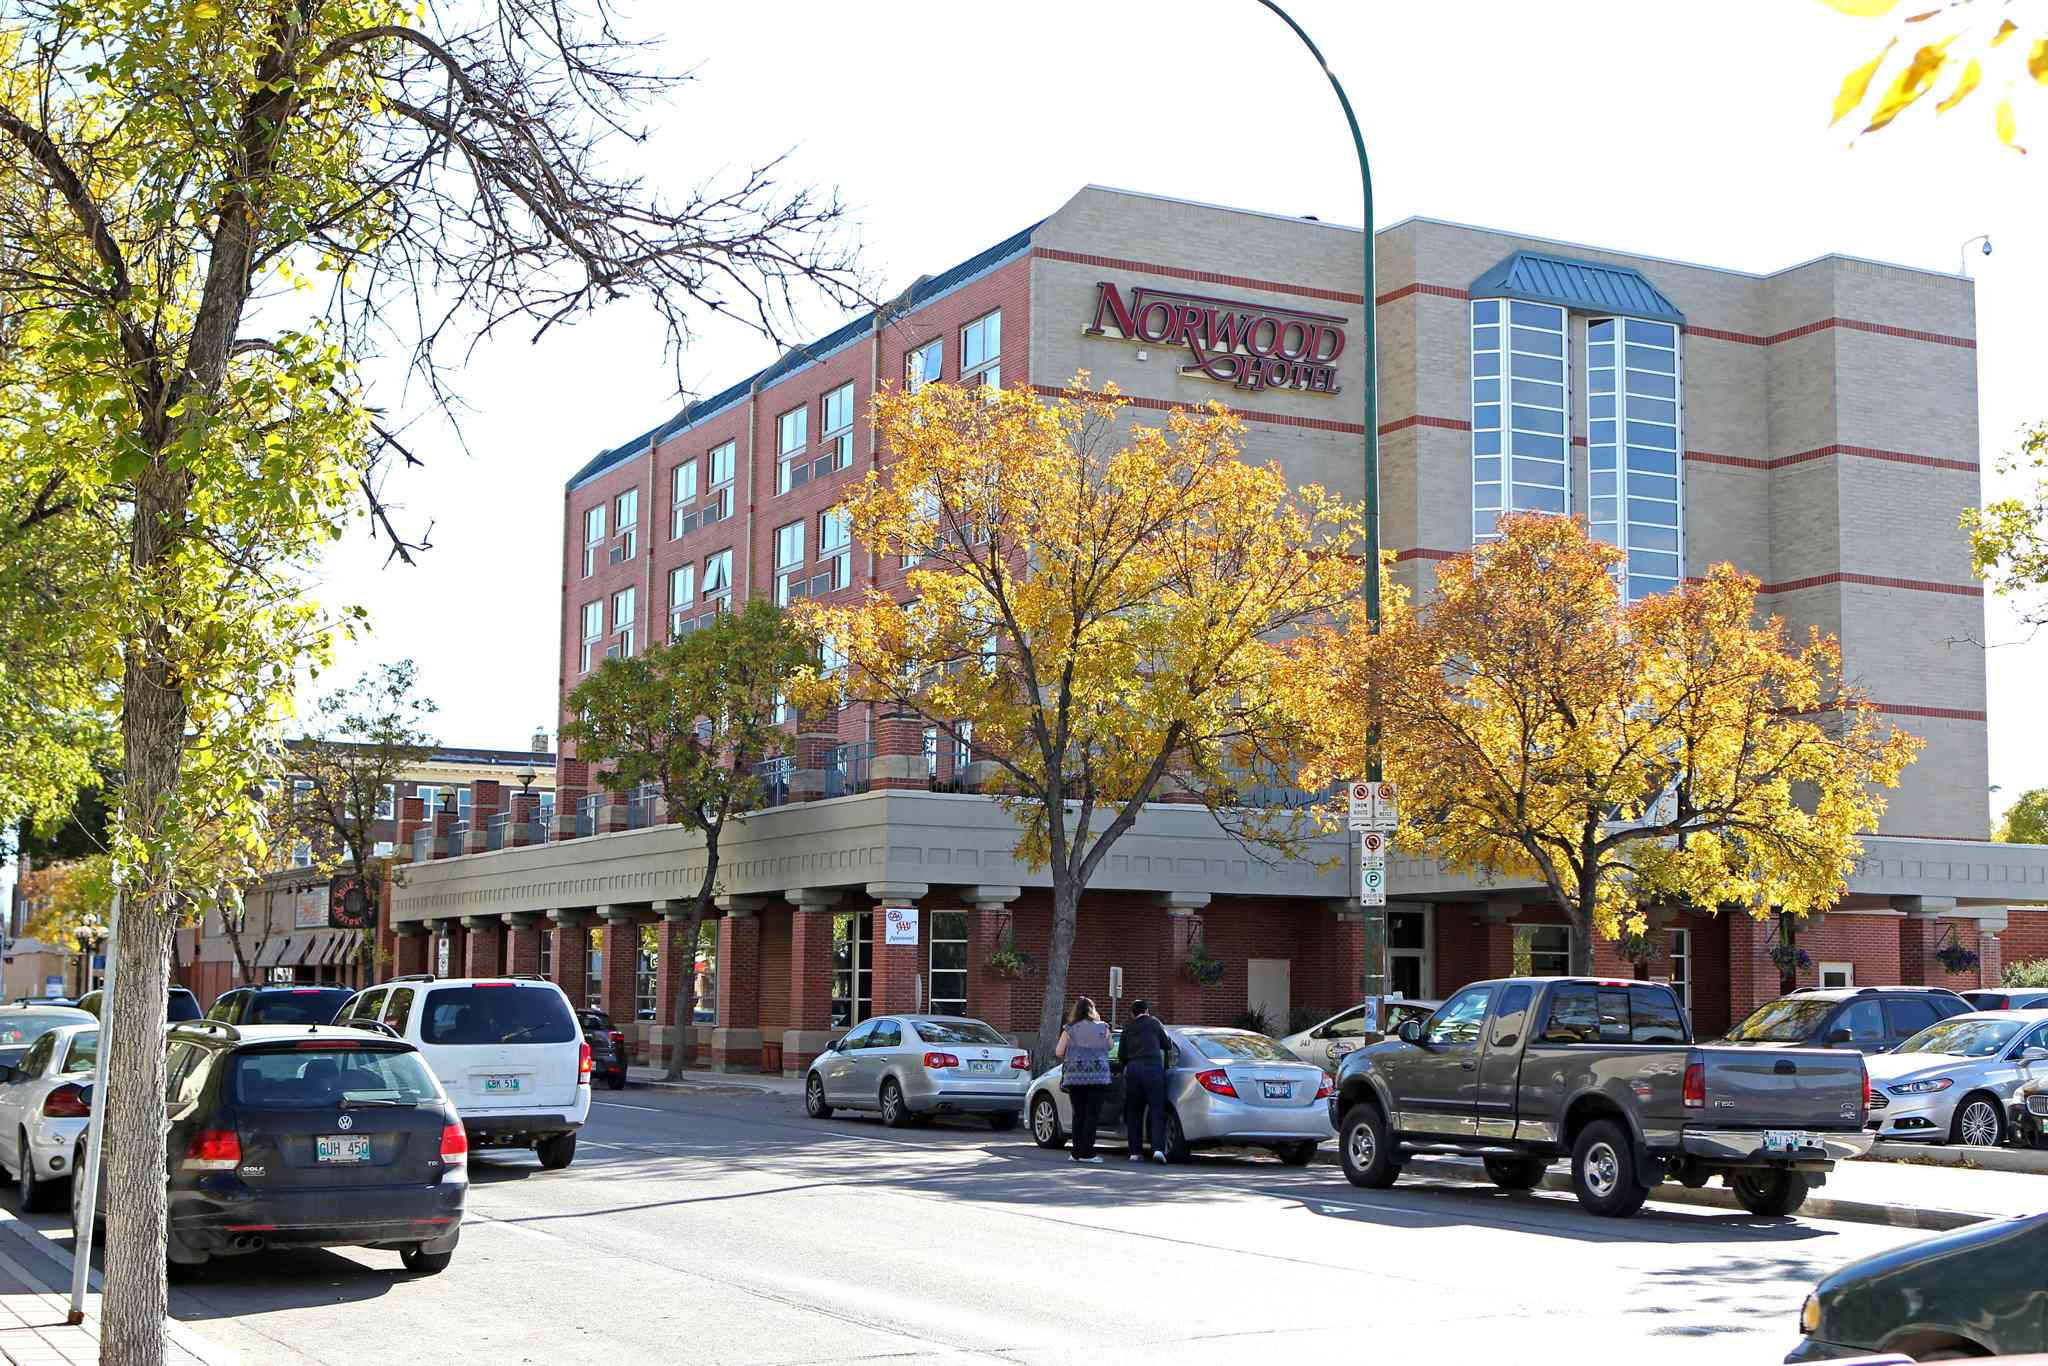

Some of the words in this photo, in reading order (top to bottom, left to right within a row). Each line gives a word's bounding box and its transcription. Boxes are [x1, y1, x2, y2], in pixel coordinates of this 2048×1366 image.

[1086, 281, 1349, 380] NORWOOD
[1233, 354, 1344, 395] HOTEL
[1369, 875, 1378, 884] P
[319, 1142, 341, 1156] GUH
[347, 1142, 369, 1155] 450
